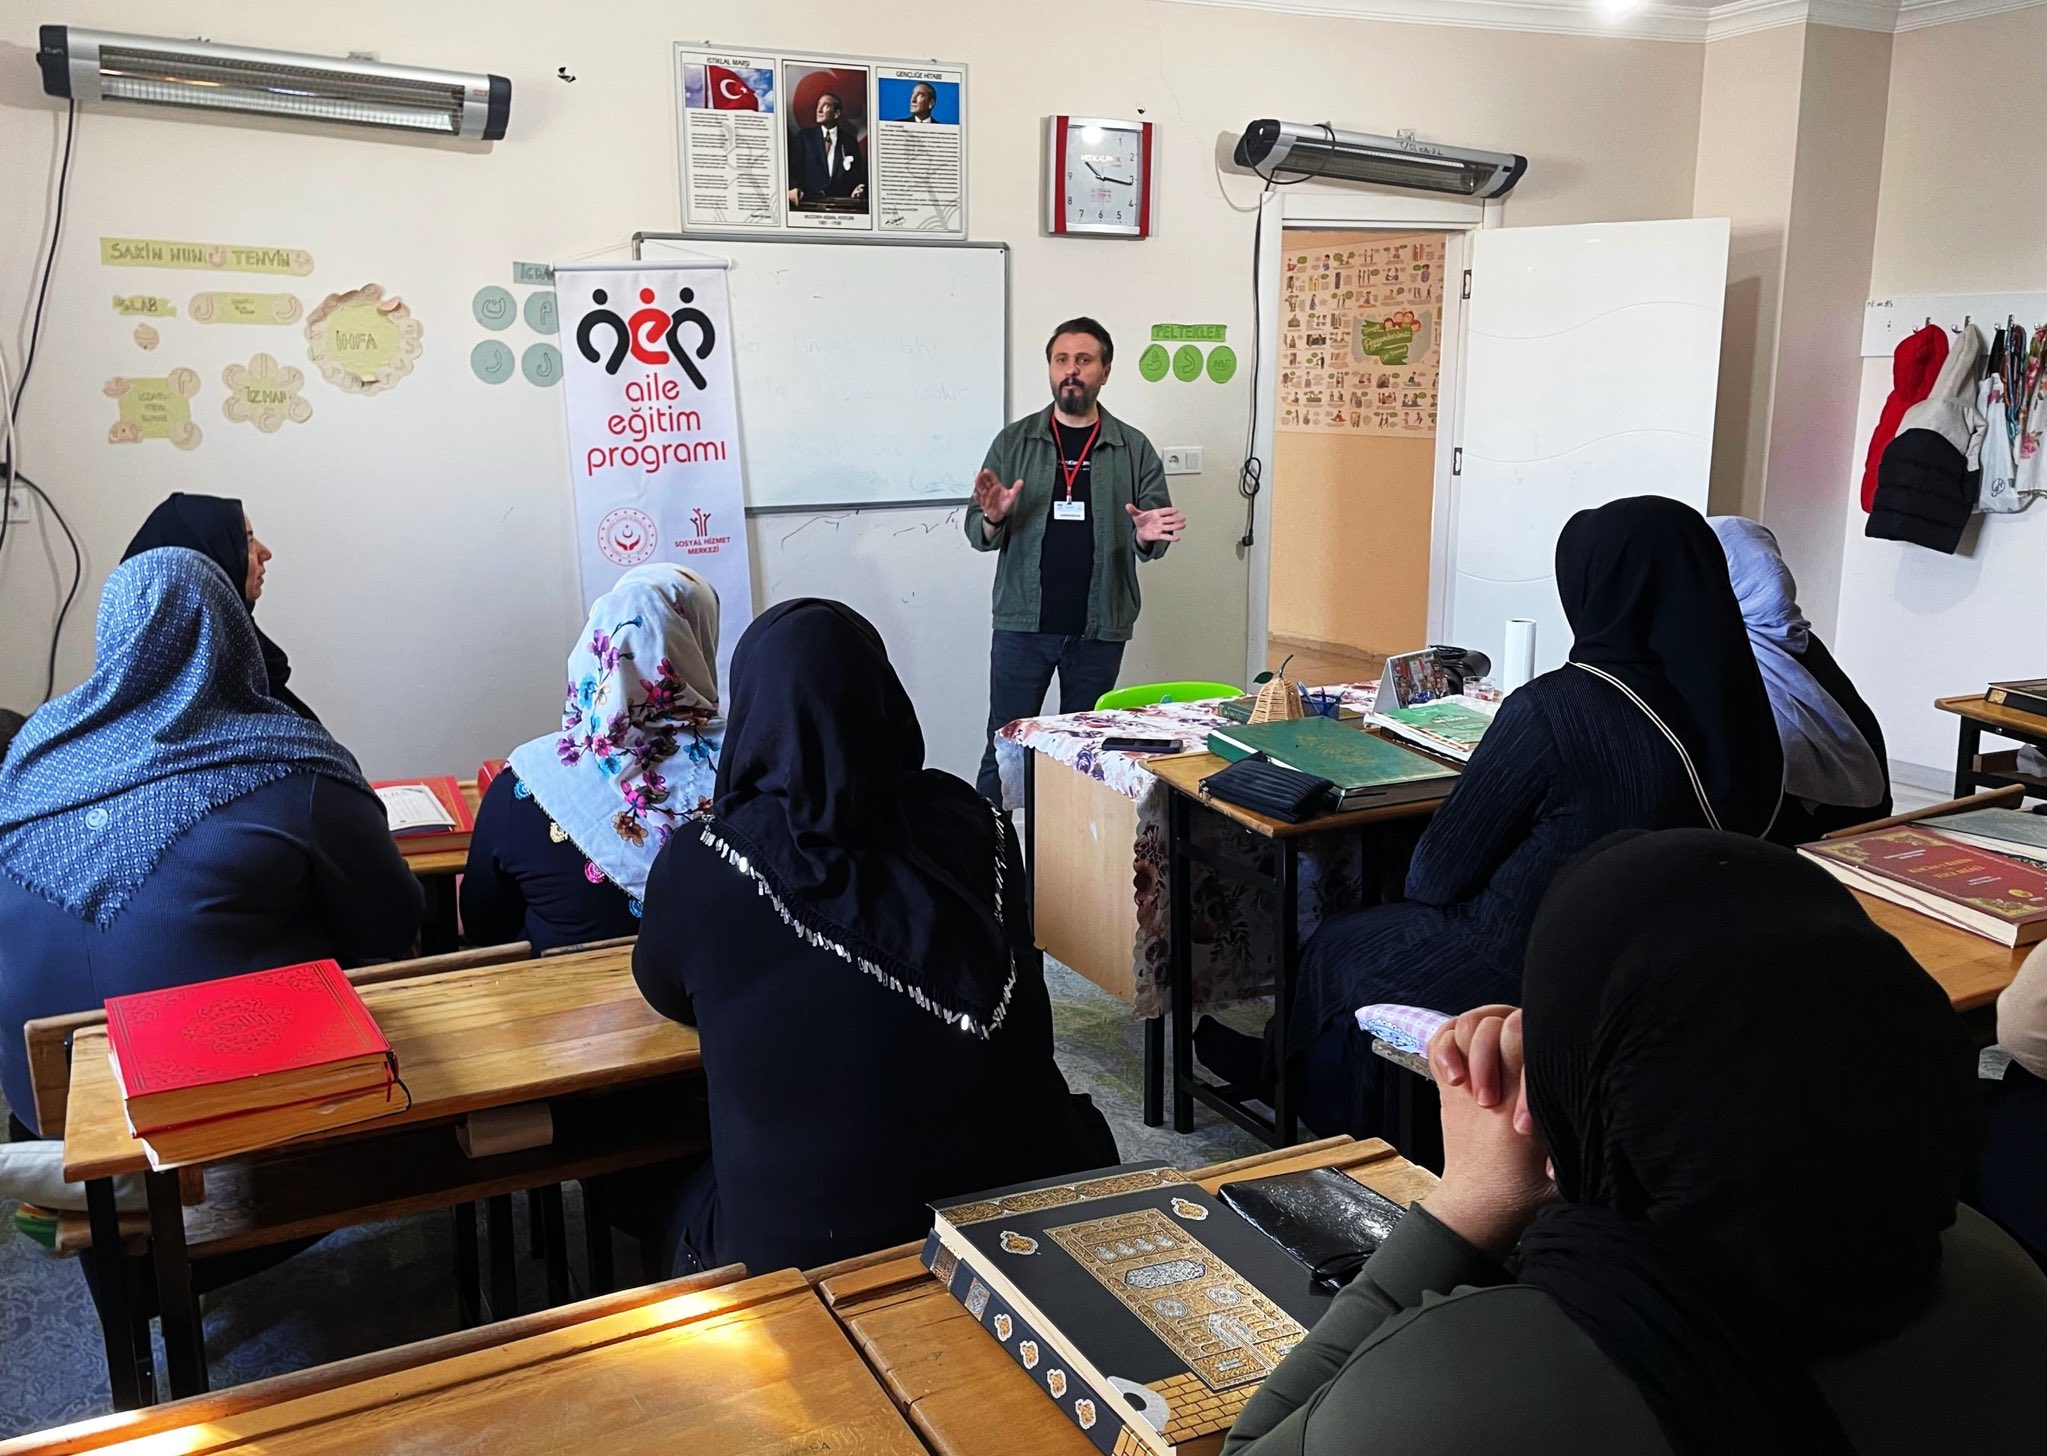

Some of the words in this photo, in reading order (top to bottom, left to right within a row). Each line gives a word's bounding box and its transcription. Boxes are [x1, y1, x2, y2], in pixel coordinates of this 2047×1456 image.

[625, 372, 680, 402] aile
[607, 405, 701, 443] eğitim
[587, 440, 726, 476] programı
[674, 539, 702, 548] SOSYAL
[704, 536, 731, 546] HİZMET
[687, 545, 719, 555] MERKEZİ
